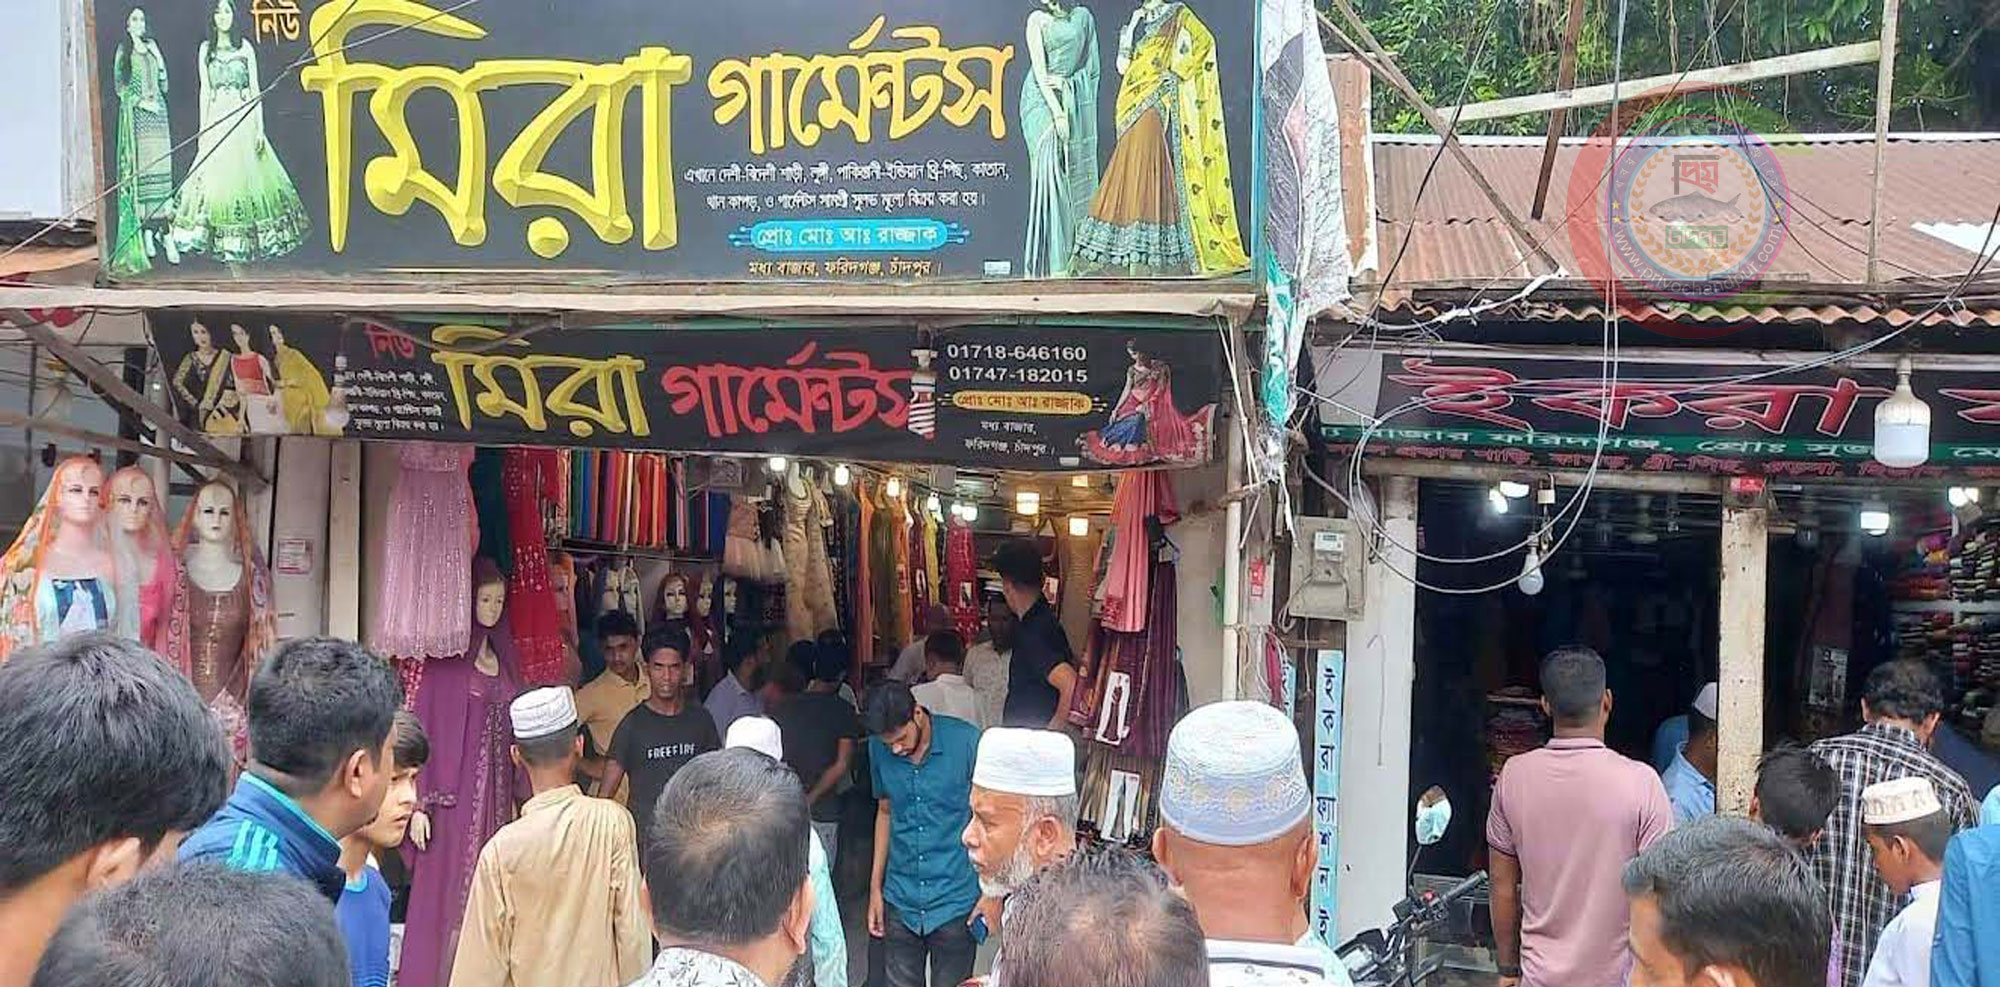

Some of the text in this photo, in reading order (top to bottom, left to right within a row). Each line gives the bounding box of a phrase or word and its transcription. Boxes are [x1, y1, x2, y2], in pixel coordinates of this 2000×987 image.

[251, 0, 301, 46] নিউ
[300, 0, 1014, 258] মিরা গার্মেন্টস
[684, 166, 716, 183] এখানে
[764, 197, 774, 207] ও
[938, 191, 959, 207] করা
[757, 225, 938, 247] প্রোঃ মোঃ আঃ রাজ্জাক
[749, 261, 772, 275] মধ্য
[776, 260, 820, 277] বাজার,
[824, 257, 884, 277] ফরিদগঞ্জ,
[947, 344, 1087, 361] 01718-646160
[431, 325, 936, 440] মিরা গার্মেন্টস
[949, 366, 1088, 384] 01747-182015
